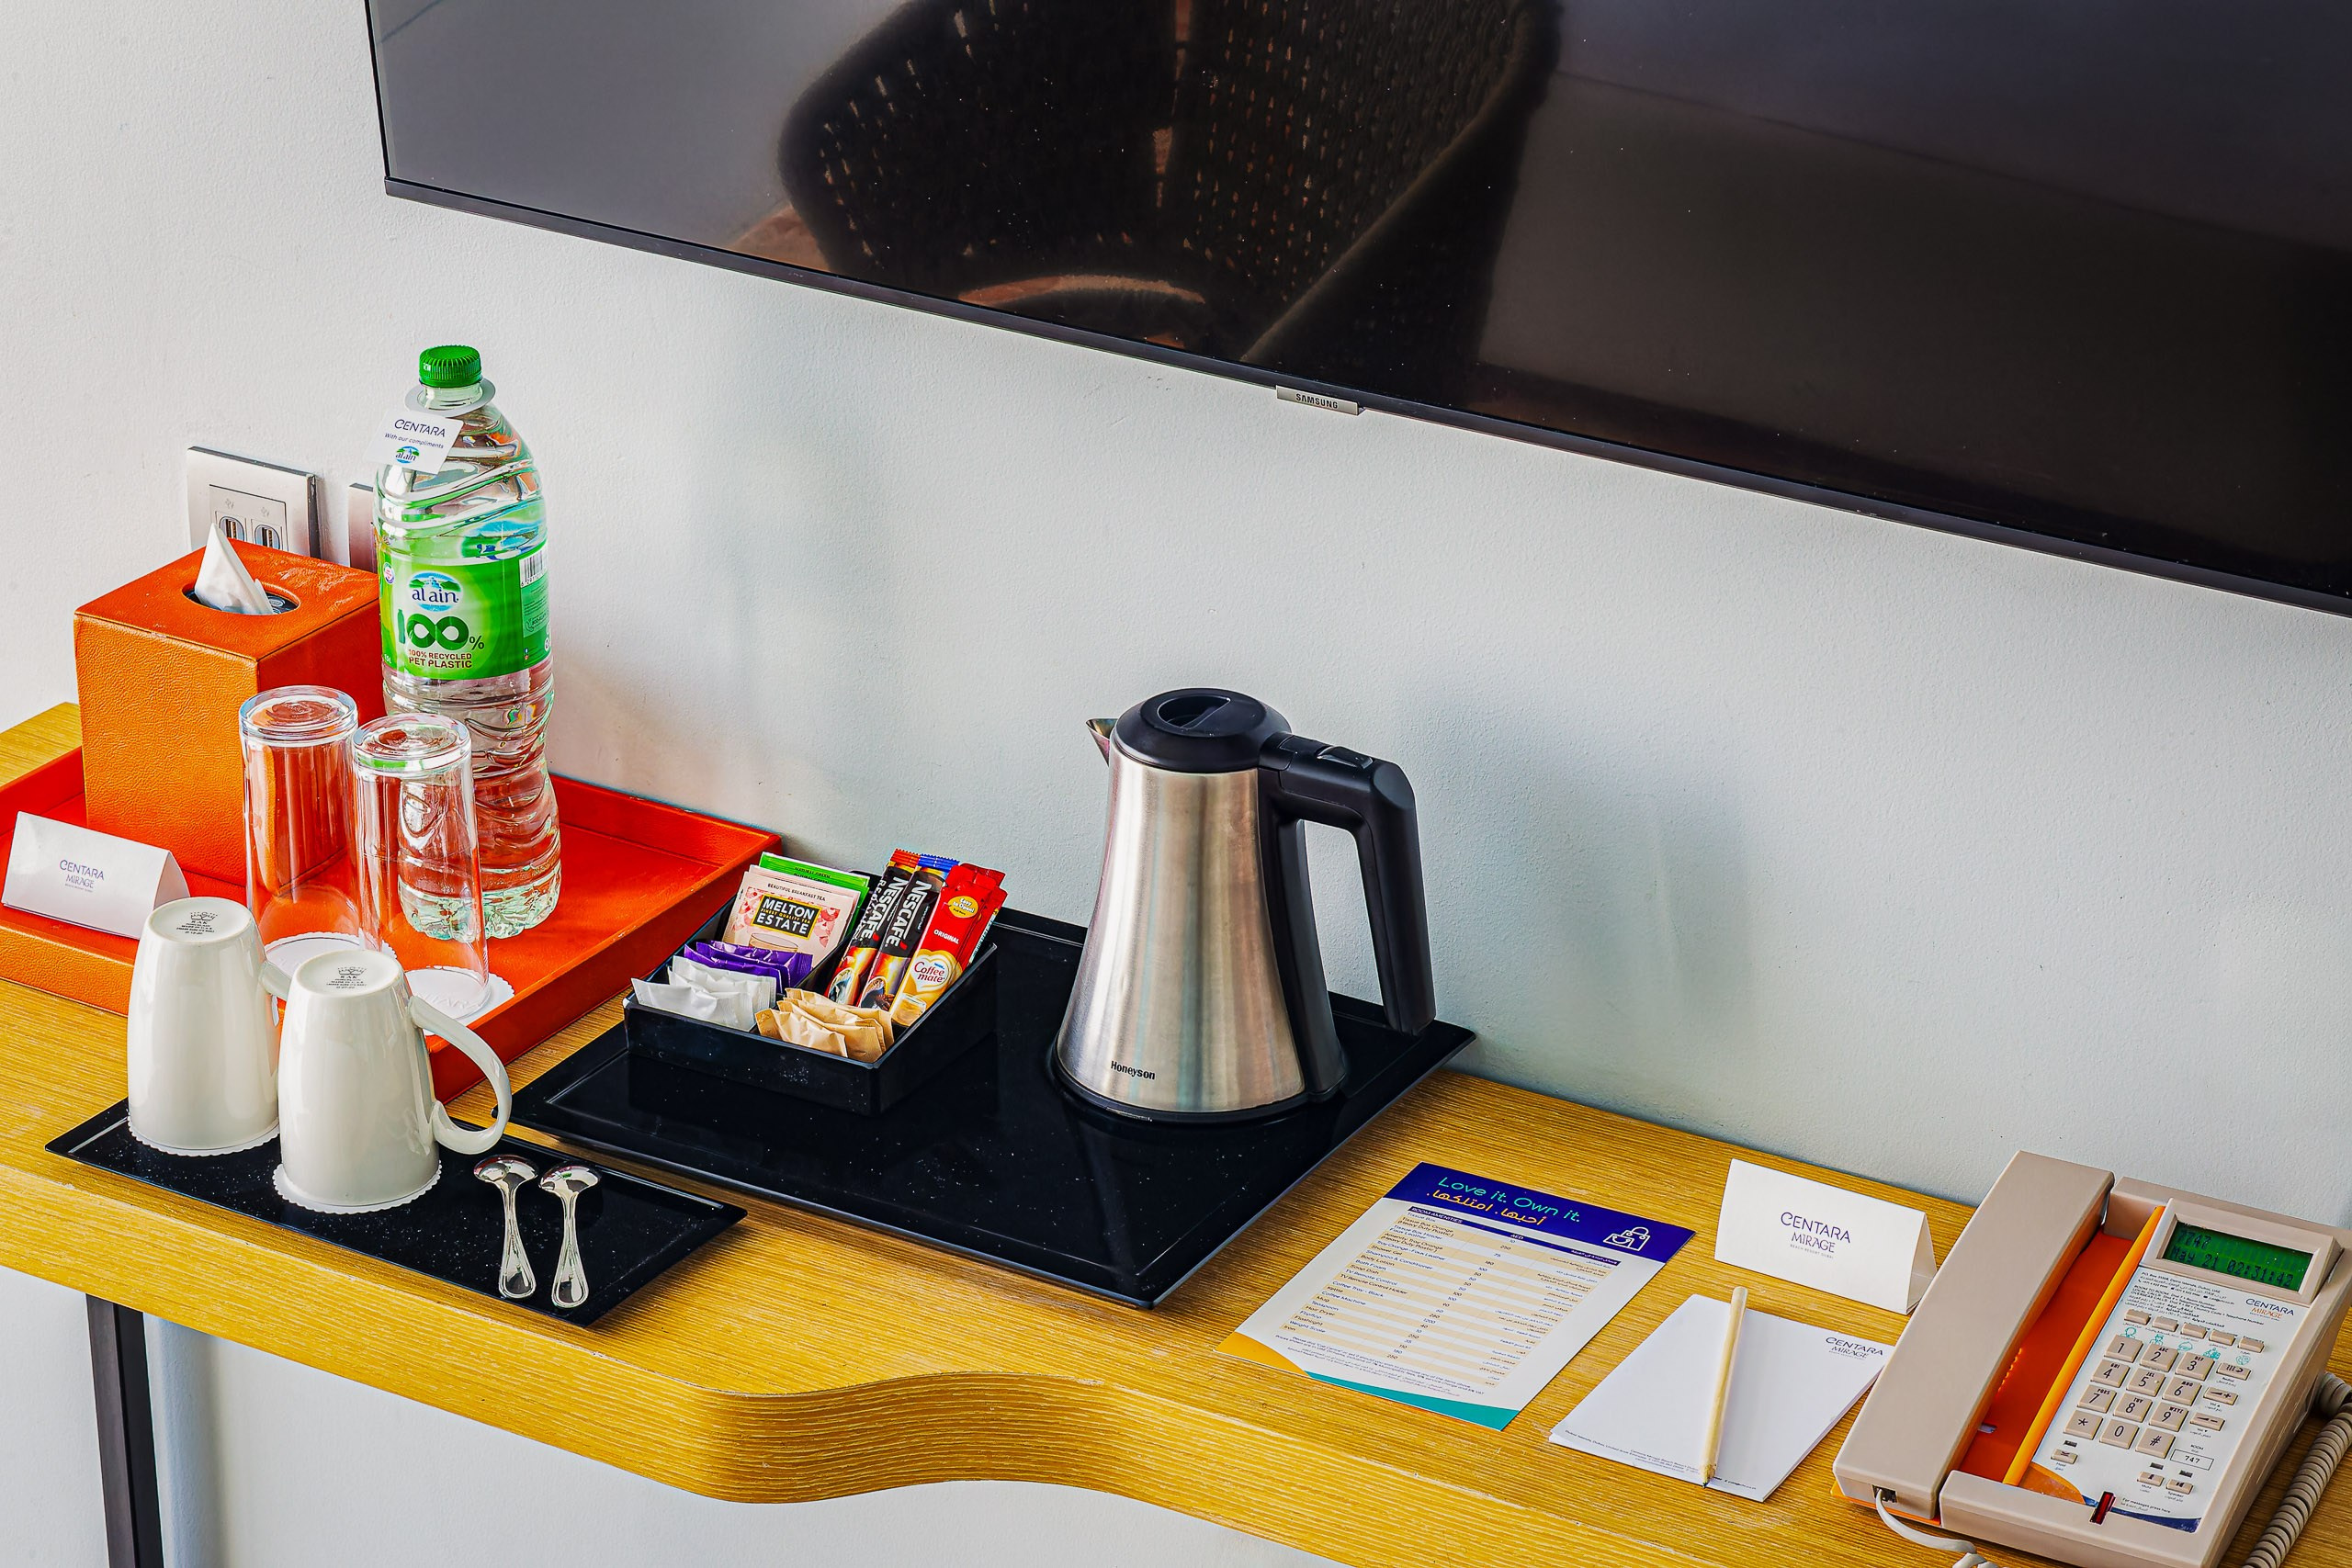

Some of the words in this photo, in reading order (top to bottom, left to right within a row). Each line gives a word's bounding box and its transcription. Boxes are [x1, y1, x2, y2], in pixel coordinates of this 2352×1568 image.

[1295, 393, 1338, 409] SAMSUNG
[394, 419, 446, 437] CENTARA
[409, 438, 444, 449] compliments
[409, 649, 426, 658] 100%
[409, 657, 425, 667] PET
[60, 859, 105, 881] CENTARA
[65, 874, 95, 889] MIRAGE
[767, 883, 790, 893] BEAUTIFUL
[791, 888, 815, 899] BREAKFAST
[959, 903, 976, 913] Open!
[960, 897, 972, 907] Easy
[763, 898, 815, 920] MELTON
[778, 912, 799, 921] QUALITY
[756, 913, 809, 934] ESTATE
[933, 929, 960, 944] ORIGINAL
[914, 961, 945, 976] Coffee
[917, 974, 944, 983] mate
[1111, 1060, 1156, 1080] Honeyson
[1438, 1177, 1487, 1197] Love
[1491, 1190, 1507, 1203] it.
[1513, 1197, 1559, 1215] Own
[1564, 1210, 1580, 1223] it.
[1411, 1207, 1430, 1215] ROOM
[1430, 1211, 1464, 1224] AMENITIES
[1781, 1212, 1850, 1244] CENTARA
[1792, 1232, 1836, 1253] MIRAGE
[2179, 1229, 2211, 1249] 7747
[2171, 1246, 2196, 1263] May
[2202, 1254, 2218, 1271] 21
[2227, 1259, 2294, 1287] 02:31:42
[2245, 1298, 2294, 1315] CENTARA
[2251, 1307, 2282, 1319] MIRAGE
[1826, 1337, 1883, 1356] CENTARA
[1831, 1346, 1869, 1359] MIRAGE
[2118, 1343, 2125, 1353] 1
[2151, 1351, 2161, 1362] 2
[2188, 1360, 2196, 1371] 3
[2104, 1369, 2112, 1379] 4
[2139, 1377, 2148, 1387] 5
[2089, 1393, 2099, 1404] 7
[2126, 1403, 2136, 1414] 8
[2163, 1411, 2172, 1422] 9
[2115, 1426, 2124, 1438] 0
[2150, 1435, 2161, 1446] #
